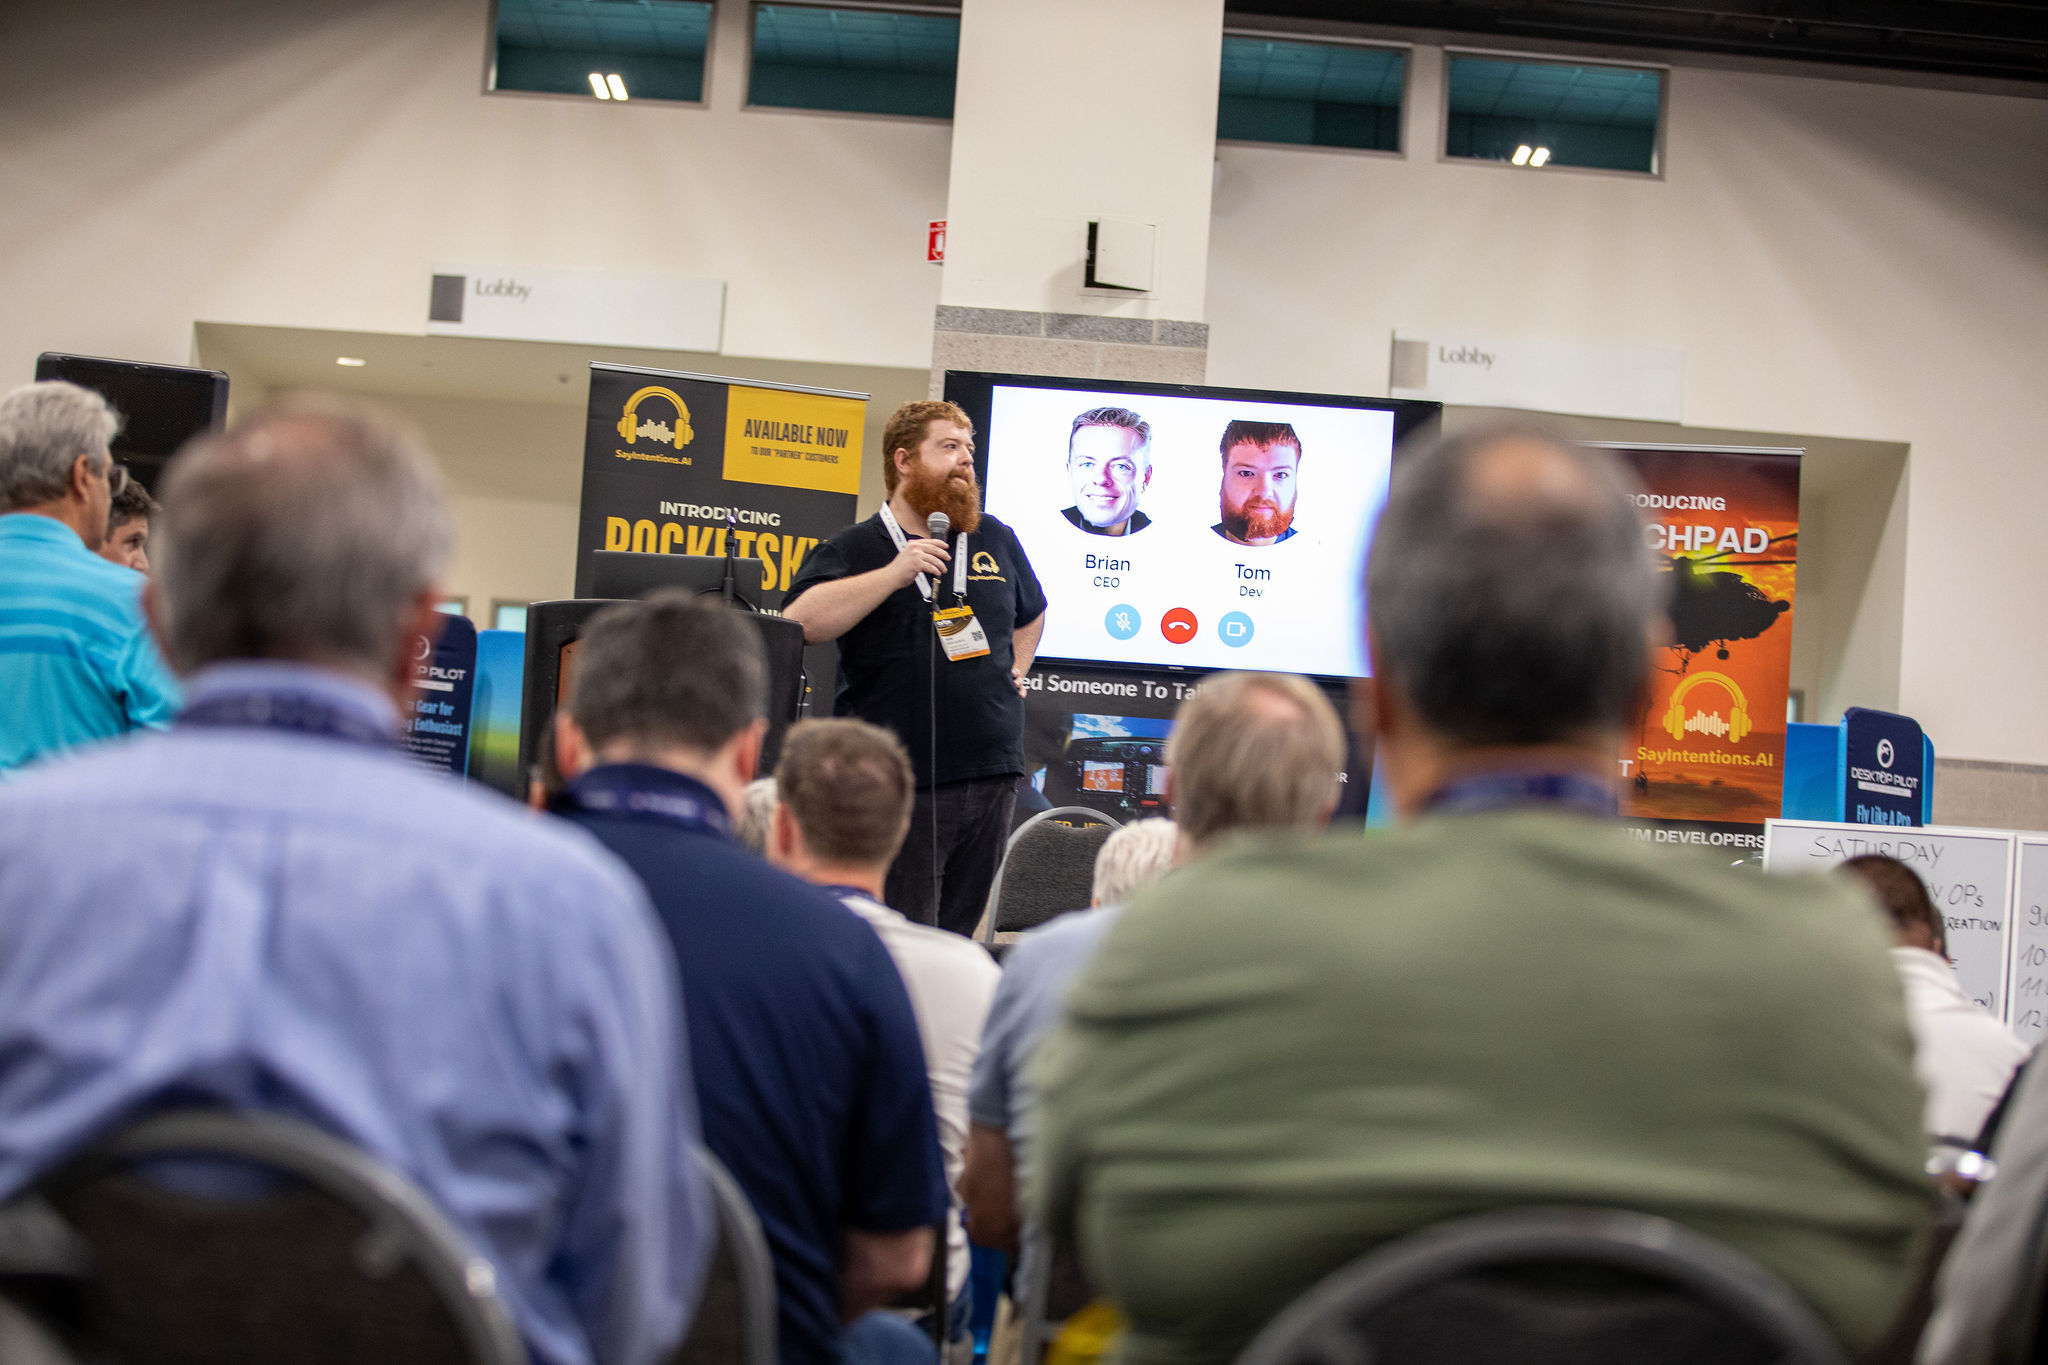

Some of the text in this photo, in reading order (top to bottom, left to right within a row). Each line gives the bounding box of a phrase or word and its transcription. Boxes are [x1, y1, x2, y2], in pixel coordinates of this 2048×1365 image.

[475, 278, 532, 301] Lobby
[1439, 345, 1496, 369] Lobby
[744, 418, 848, 448] AVAILABLE NOW
[1085, 554, 1131, 571] Brian
[1235, 563, 1271, 581] Tom
[1093, 576, 1120, 588] CEO
[1239, 585, 1264, 598] Dev
[429, 667, 466, 680] PILOT
[1047, 675, 1138, 697] Someone
[1142, 680, 1168, 698] To
[415, 718, 463, 736] Enthusiast
[1637, 746, 1773, 767] SayIntentions.AI
[1851, 766, 1918, 789] DESKTOP PILOT
[1655, 829, 1764, 849] DEVELOPERS
